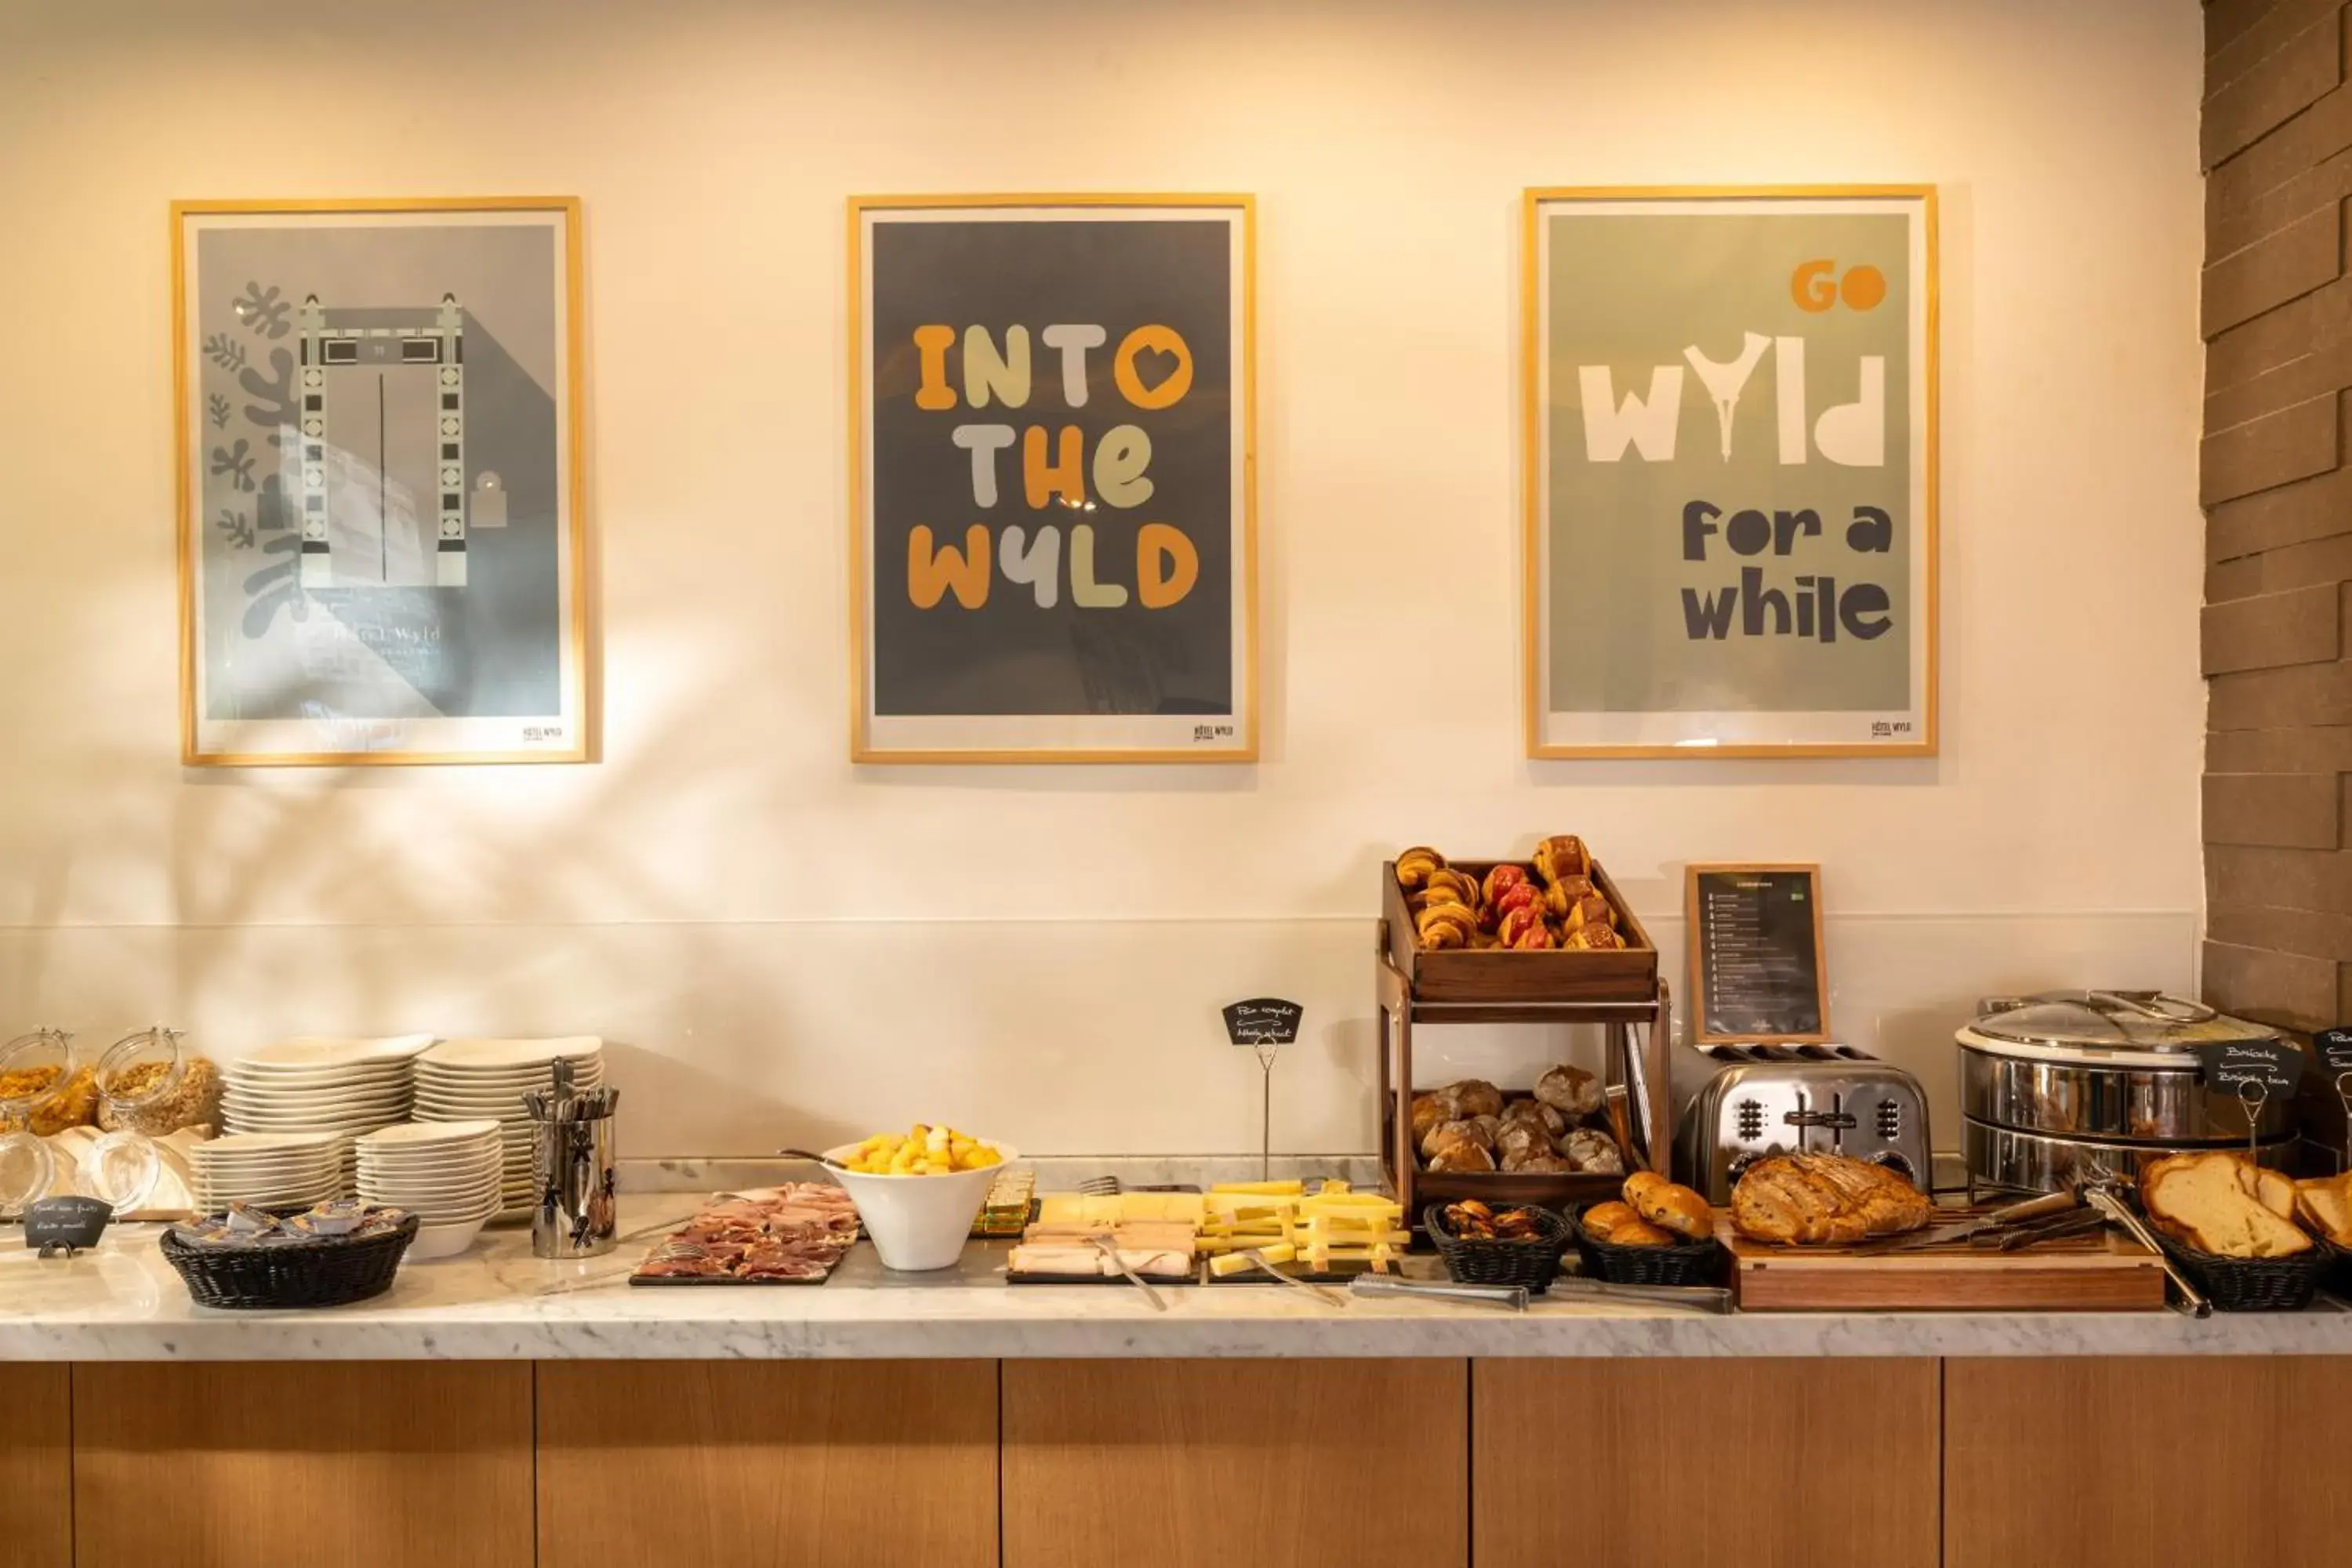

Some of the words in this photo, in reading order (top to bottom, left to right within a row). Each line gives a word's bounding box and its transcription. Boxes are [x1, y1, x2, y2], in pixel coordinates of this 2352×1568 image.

[1791, 260, 1886, 313] GO
[913, 324, 1193, 410] INTO
[1682, 500, 1822, 561] for
[1846, 506, 1893, 553] a
[1681, 566, 1893, 644] while
